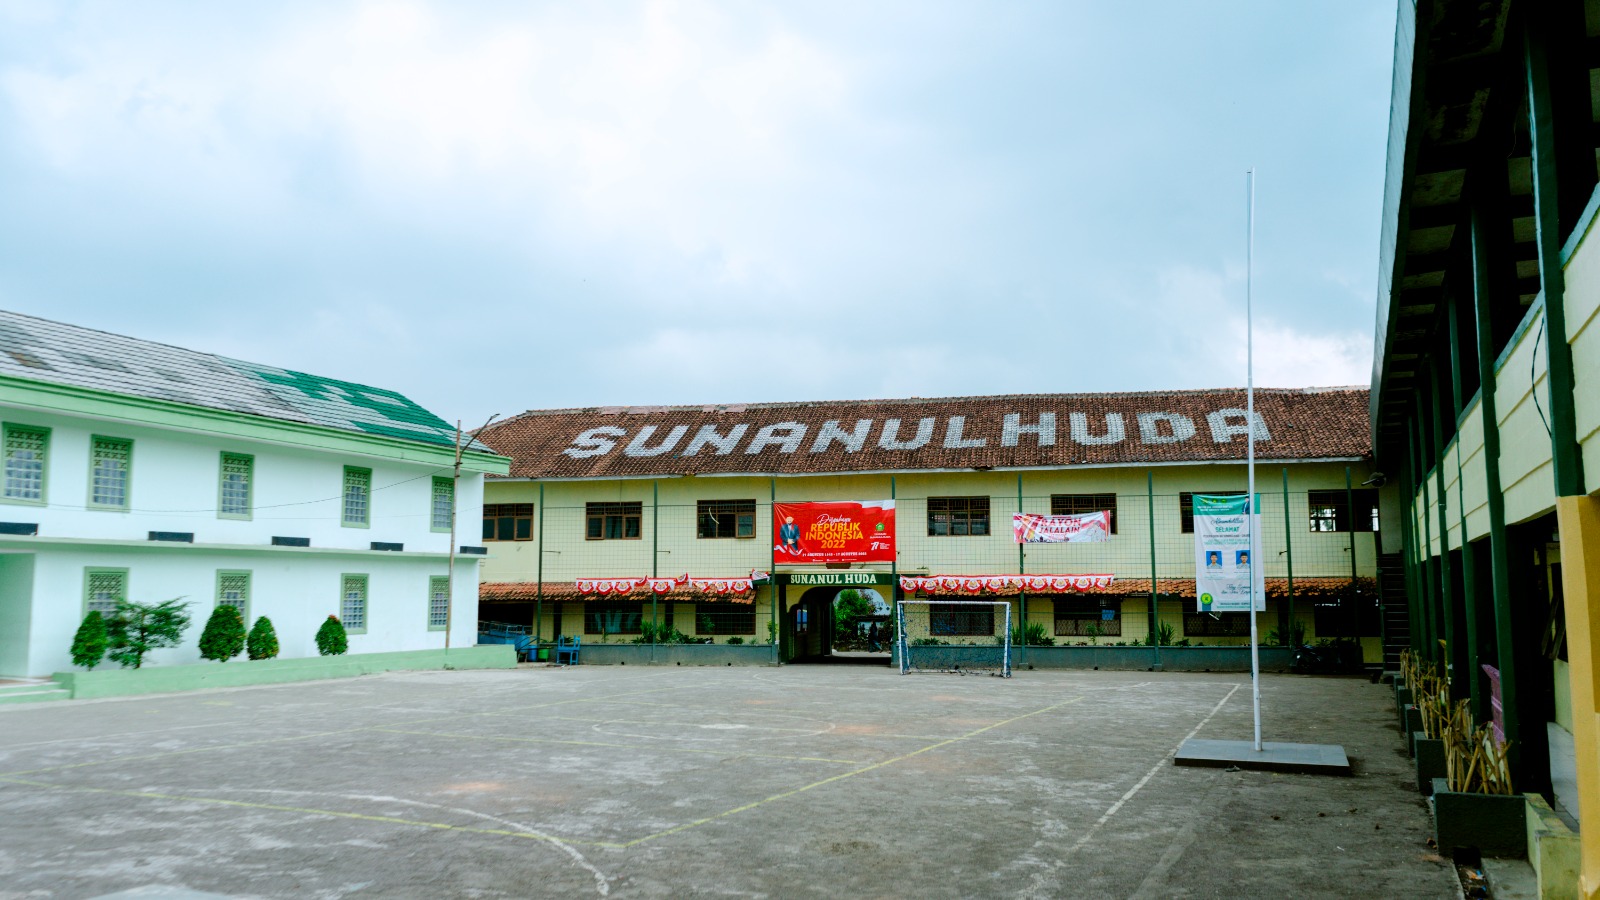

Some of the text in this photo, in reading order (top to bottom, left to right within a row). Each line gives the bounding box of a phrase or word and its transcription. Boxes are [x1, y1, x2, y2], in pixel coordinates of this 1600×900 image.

[811, 522, 860, 532] REPUBLIK
[1040, 518, 1082, 527] RAYON
[1038, 526, 1081, 534] JALALAIN
[805, 531, 864, 541] INDONESIA
[821, 539, 846, 549] 2022
[790, 573, 877, 585] SUNANUL HUDA
